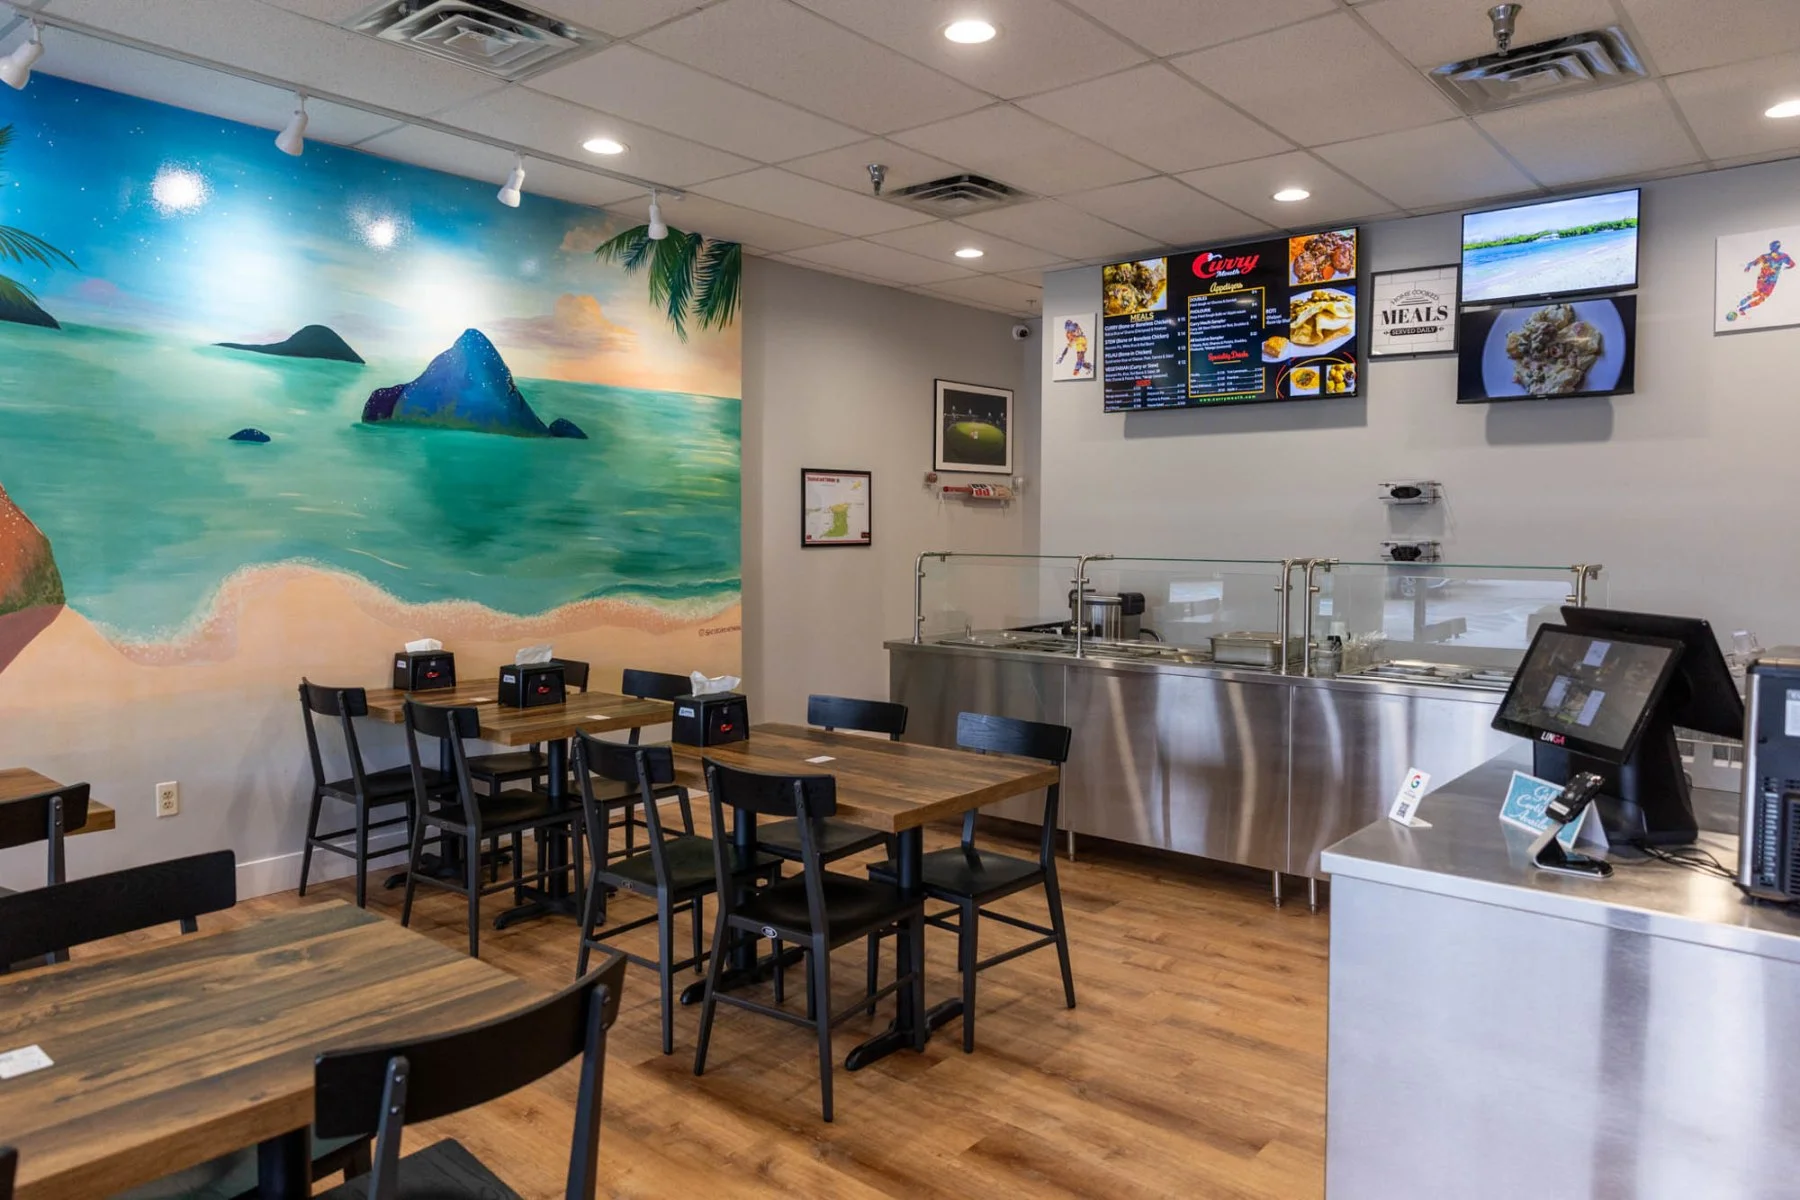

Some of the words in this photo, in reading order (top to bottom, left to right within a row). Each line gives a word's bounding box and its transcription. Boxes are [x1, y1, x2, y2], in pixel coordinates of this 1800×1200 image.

[1192, 252, 1260, 279] Curry
[1209, 282, 1244, 294] Appetizers
[1390, 291, 1410, 304] HOME
[1412, 289, 1440, 301] COOKED
[1130, 312, 1154, 322] MEALS
[1381, 305, 1448, 326] MEALS
[1392, 327, 1416, 335] SERVED
[1416, 326, 1435, 334] DAILY
[1540, 731, 1566, 745] LINGA
